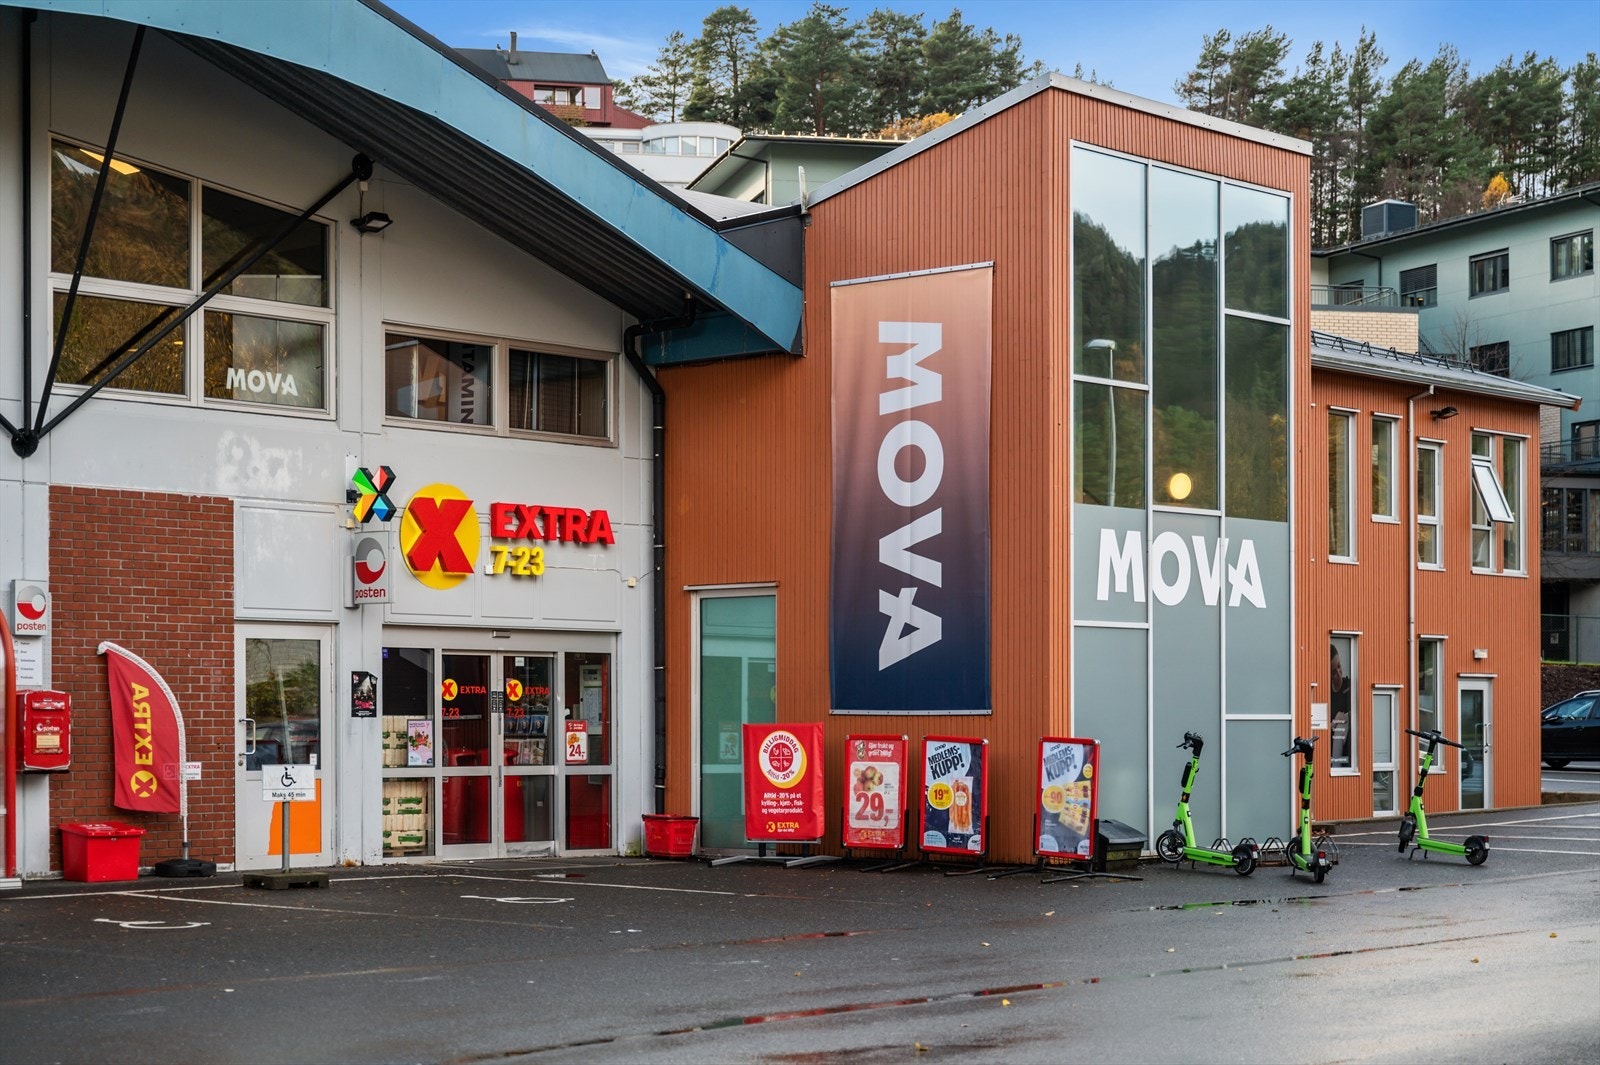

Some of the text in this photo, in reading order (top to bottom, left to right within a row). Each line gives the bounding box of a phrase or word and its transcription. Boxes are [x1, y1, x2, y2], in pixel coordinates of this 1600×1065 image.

[226, 367, 299, 397] MOVA
[877, 321, 944, 671] MOVA
[490, 502, 615, 545] EXTRA
[490, 545, 545, 576] 7-23
[1097, 528, 1267, 608] MOVA
[355, 587, 386, 600] posten
[16, 621, 47, 632] posten
[460, 686, 487, 694] EXTRA
[524, 686, 551, 695] EXTRA
[441, 707, 460, 718] 7-23
[507, 708, 525, 718] 7-23
[762, 734, 799, 754] BILLIGMIDDAG
[930, 753, 965, 780] KUPP!
[1045, 754, 1078, 782] KUPP!
[767, 769, 780, 780] Alltid
[272, 791, 306, 800] Maks 45 min
[777, 821, 799, 829] EXTRA
